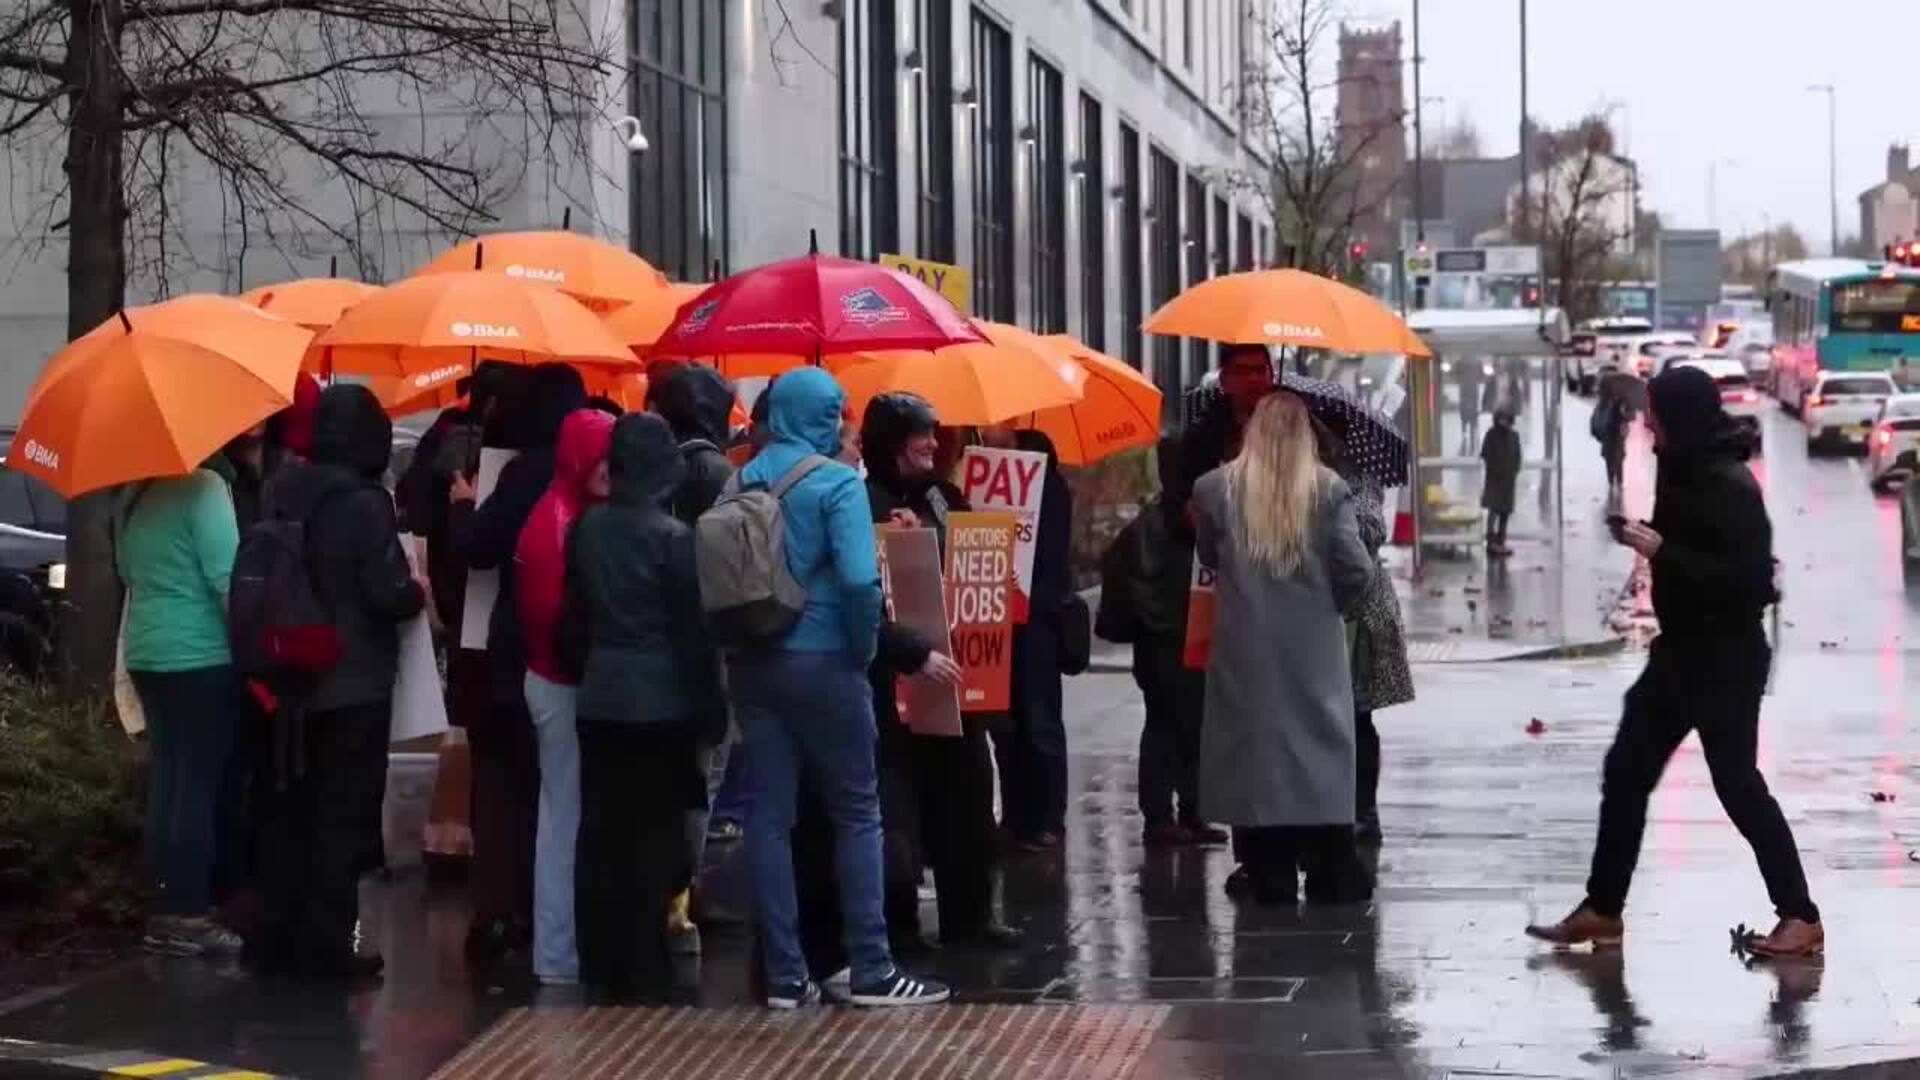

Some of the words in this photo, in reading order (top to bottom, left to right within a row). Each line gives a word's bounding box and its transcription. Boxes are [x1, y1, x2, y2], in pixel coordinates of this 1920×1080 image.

[525, 267, 566, 283] BMA
[473, 323, 520, 338] BMA
[1283, 324, 1326, 339] BMA
[430, 364, 464, 383] BMA
[35, 443, 59, 470] BMA
[963, 453, 1041, 508] PAY
[953, 526, 1009, 548] DOCTORS
[952, 550, 1008, 583] NEED
[950, 586, 1006, 631] JOBS
[951, 630, 1003, 668] NOW
